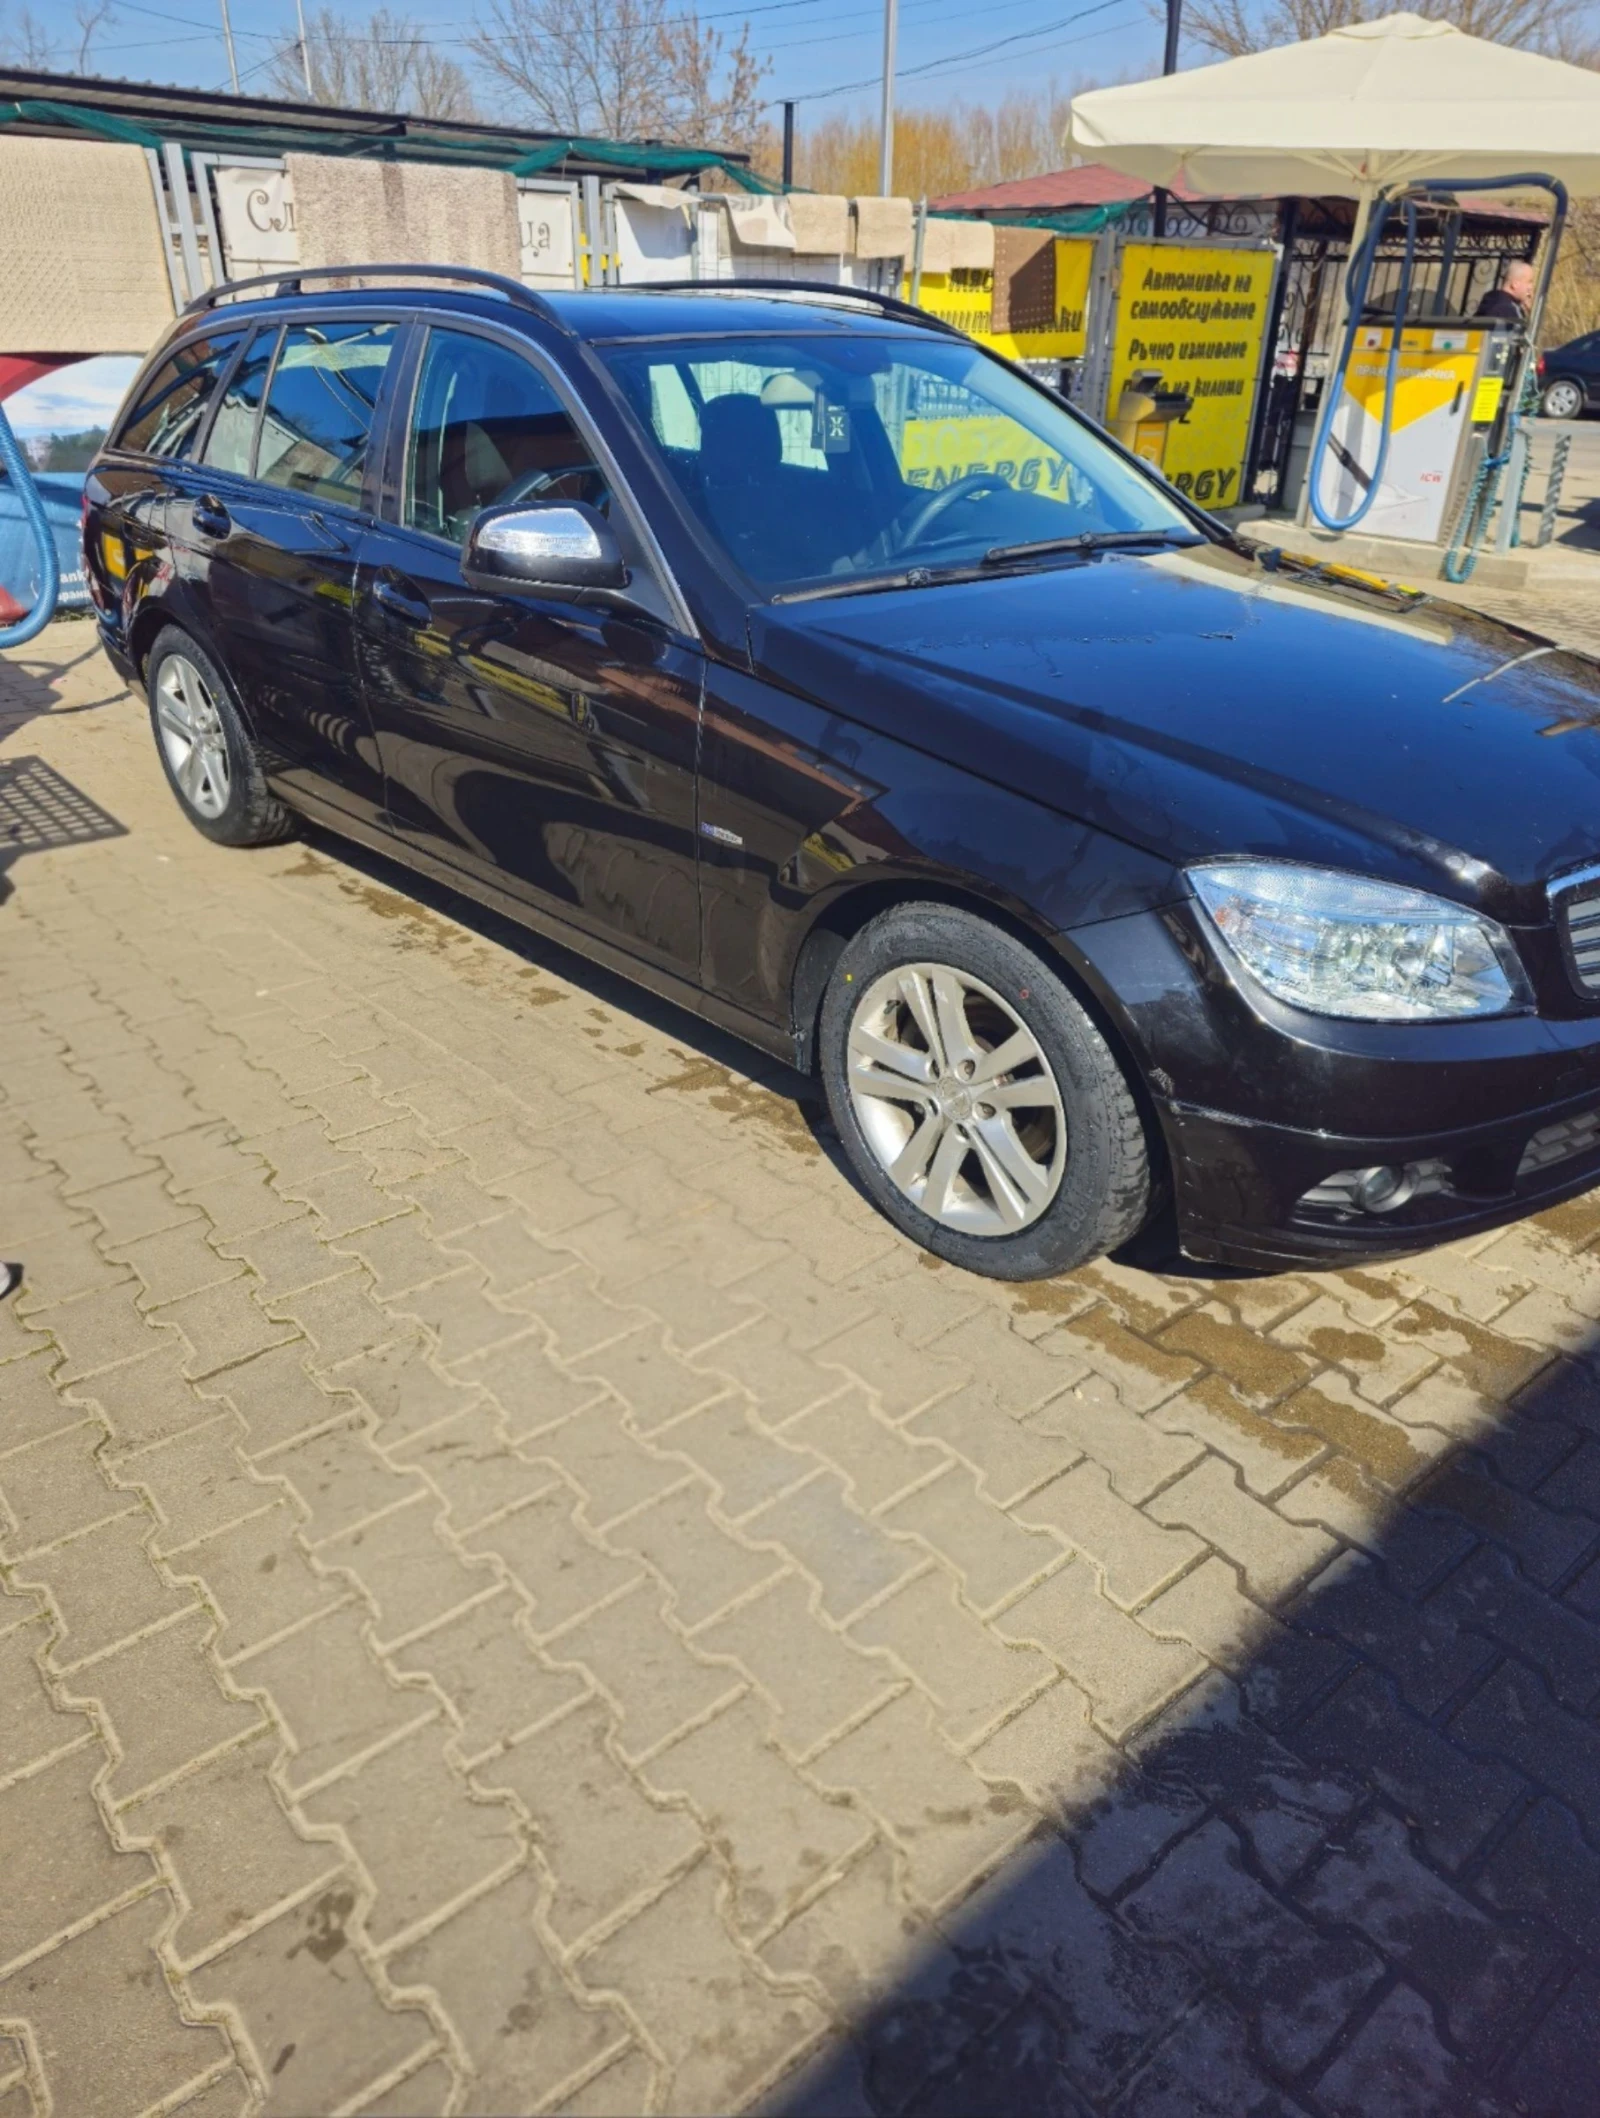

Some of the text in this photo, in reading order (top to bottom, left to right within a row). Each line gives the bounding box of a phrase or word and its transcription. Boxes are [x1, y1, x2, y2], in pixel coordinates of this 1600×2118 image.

[1142, 267, 1252, 293] Автомивка на
[1128, 338, 1248, 361] Ръчно измиване
[1193, 377, 1245, 397] килими
